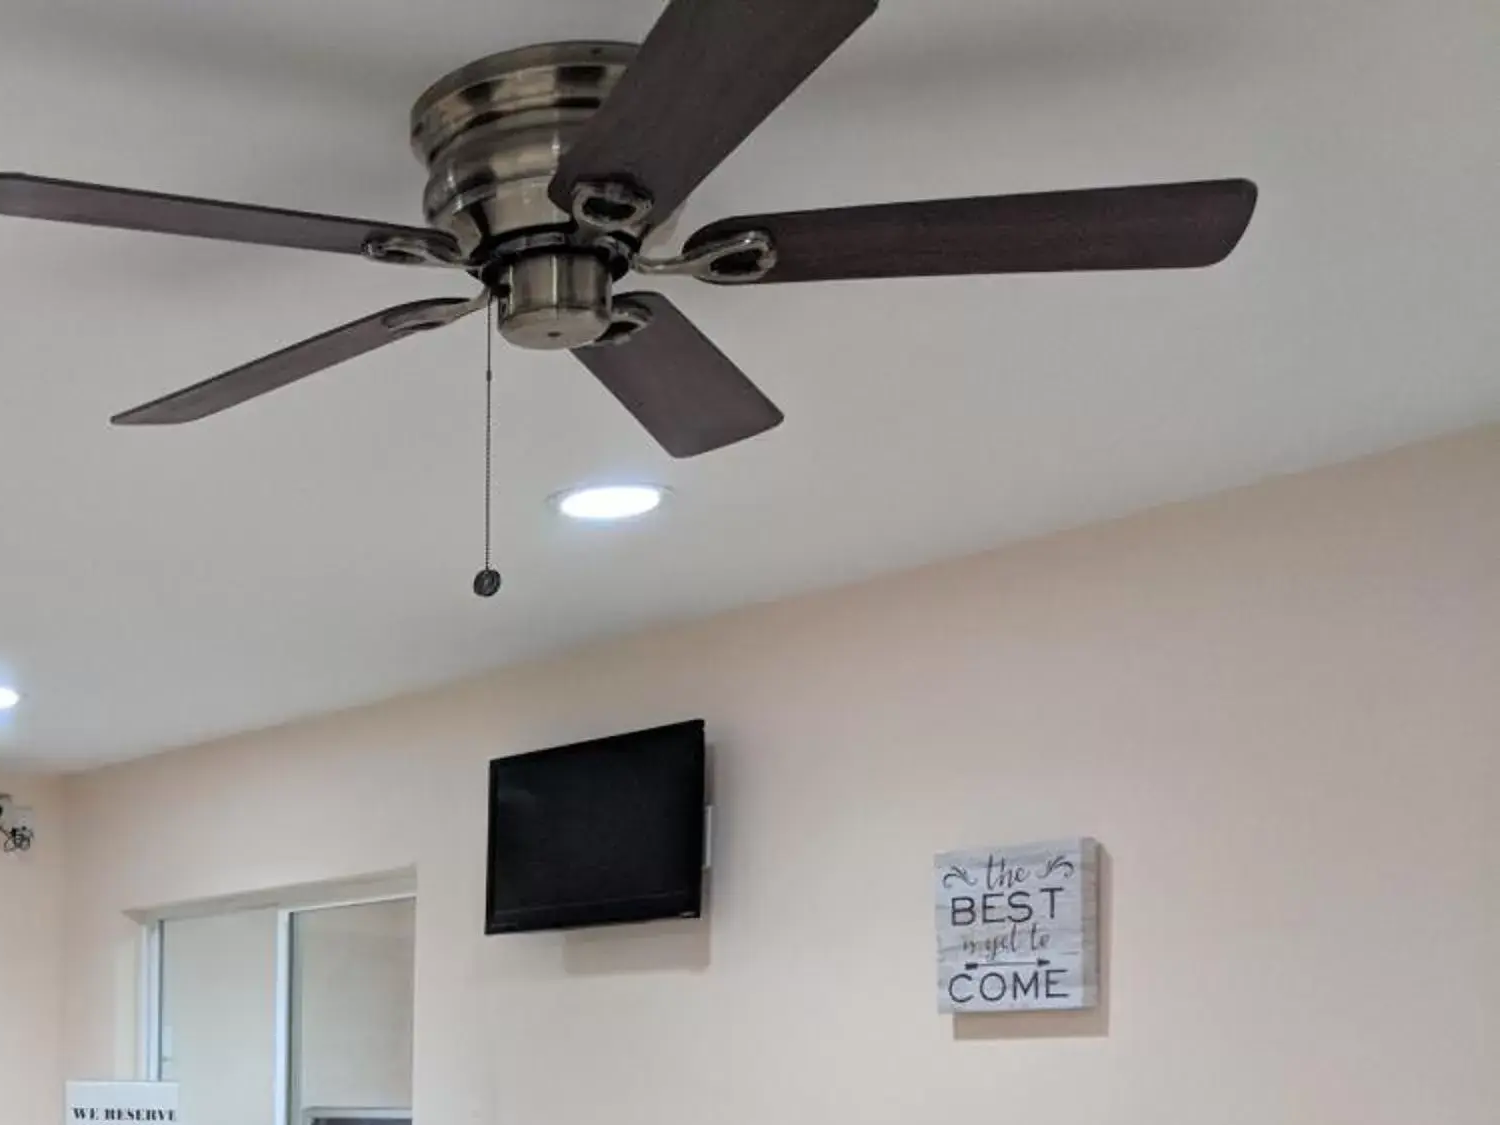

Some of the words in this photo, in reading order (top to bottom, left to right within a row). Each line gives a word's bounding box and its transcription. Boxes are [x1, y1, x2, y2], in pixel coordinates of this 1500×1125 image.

[985, 854, 1030, 890] the
[951, 886, 1065, 926] BEST
[1030, 922, 1050, 951] to
[948, 969, 1071, 1004] COME
[72, 1107, 99, 1121] WE
[104, 1108, 177, 1122] RESERVE
